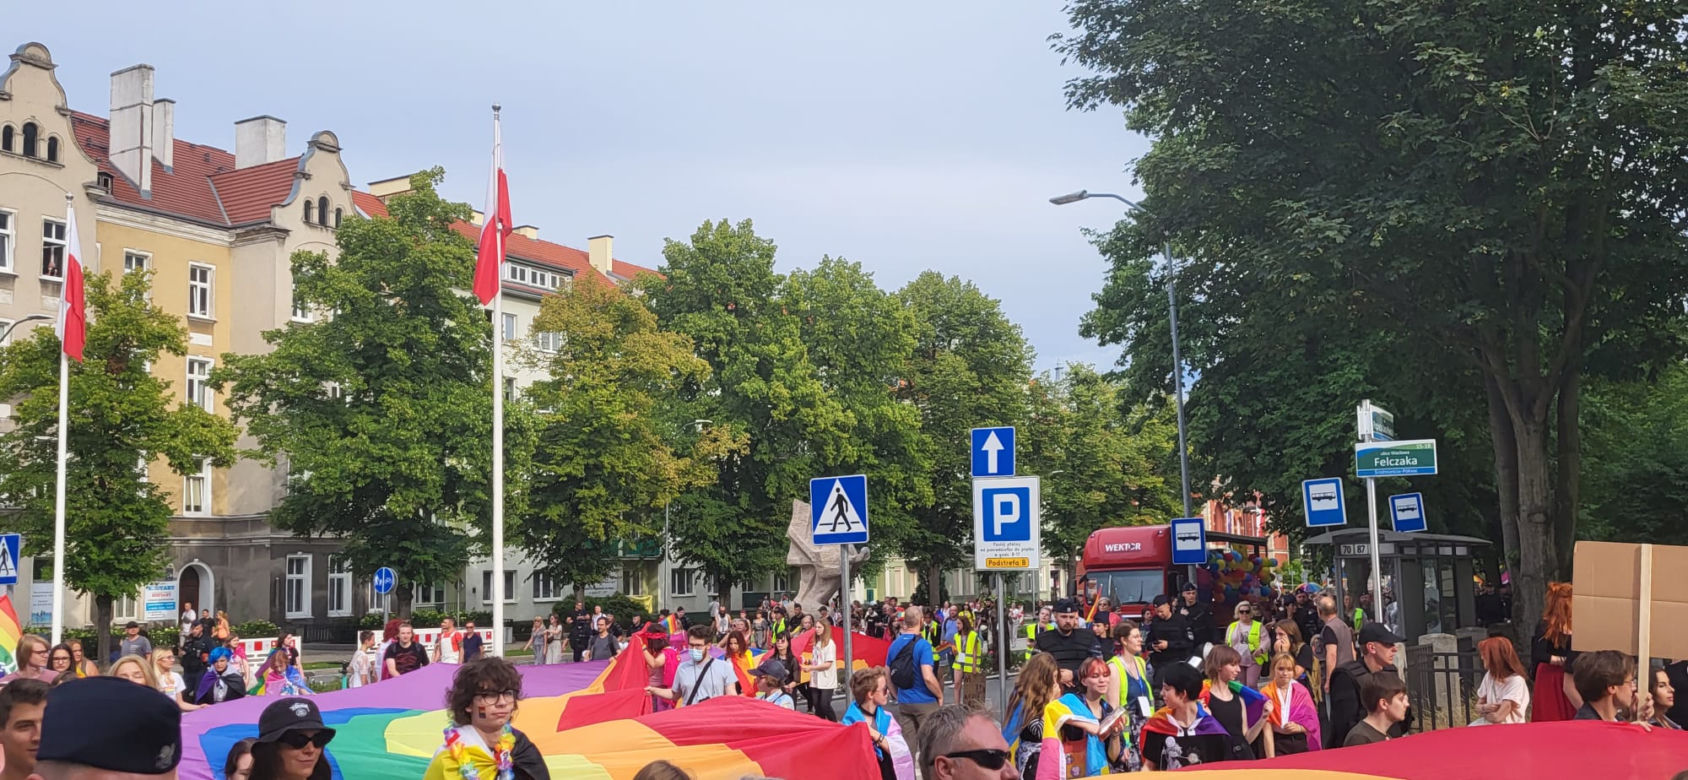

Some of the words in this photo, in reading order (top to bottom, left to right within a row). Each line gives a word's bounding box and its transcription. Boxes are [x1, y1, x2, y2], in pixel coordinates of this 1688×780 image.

[1374, 456, 1418, 467] Felczaka
[994, 494, 1020, 535] P
[1105, 543, 1141, 552] WEKTOR
[1343, 545, 1351, 554] 70
[1357, 544, 1365, 553] 87
